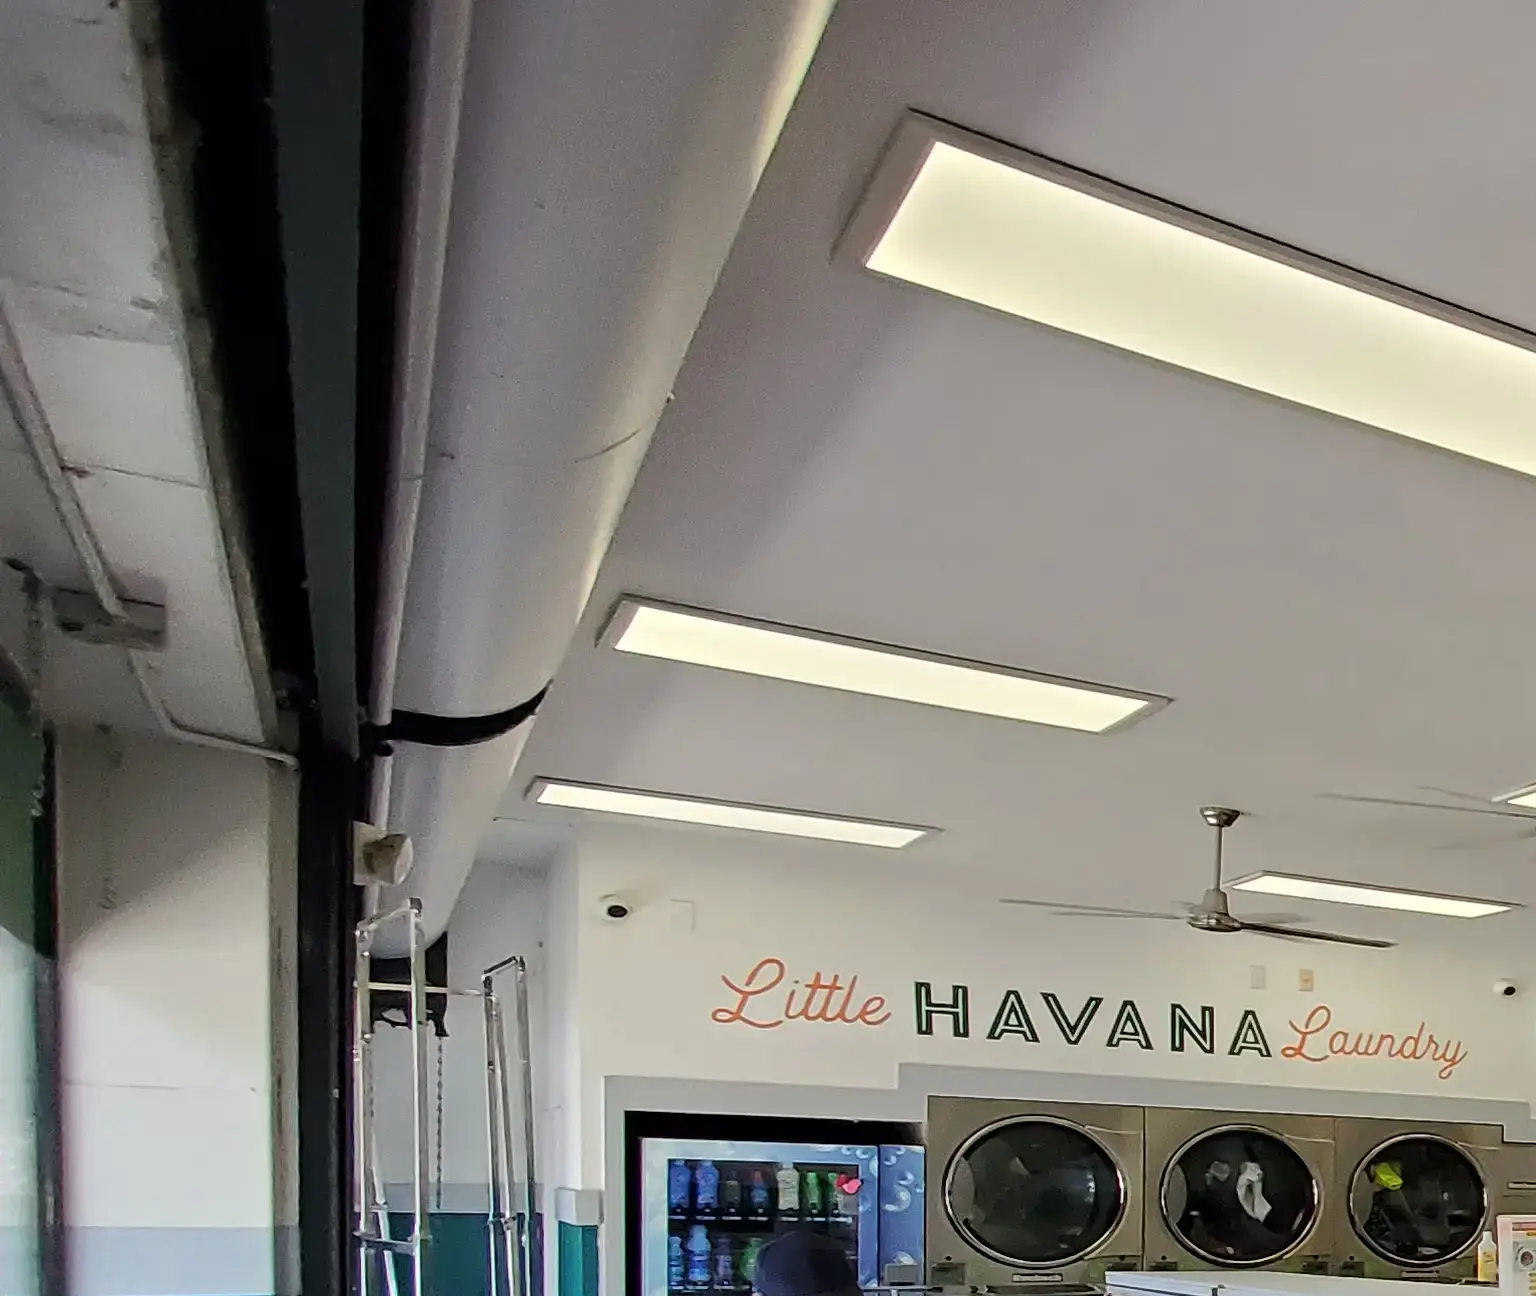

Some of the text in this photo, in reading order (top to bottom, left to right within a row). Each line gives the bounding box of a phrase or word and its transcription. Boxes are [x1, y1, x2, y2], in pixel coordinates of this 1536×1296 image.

[711, 957, 1468, 1080] Little HAVANA Laundry
